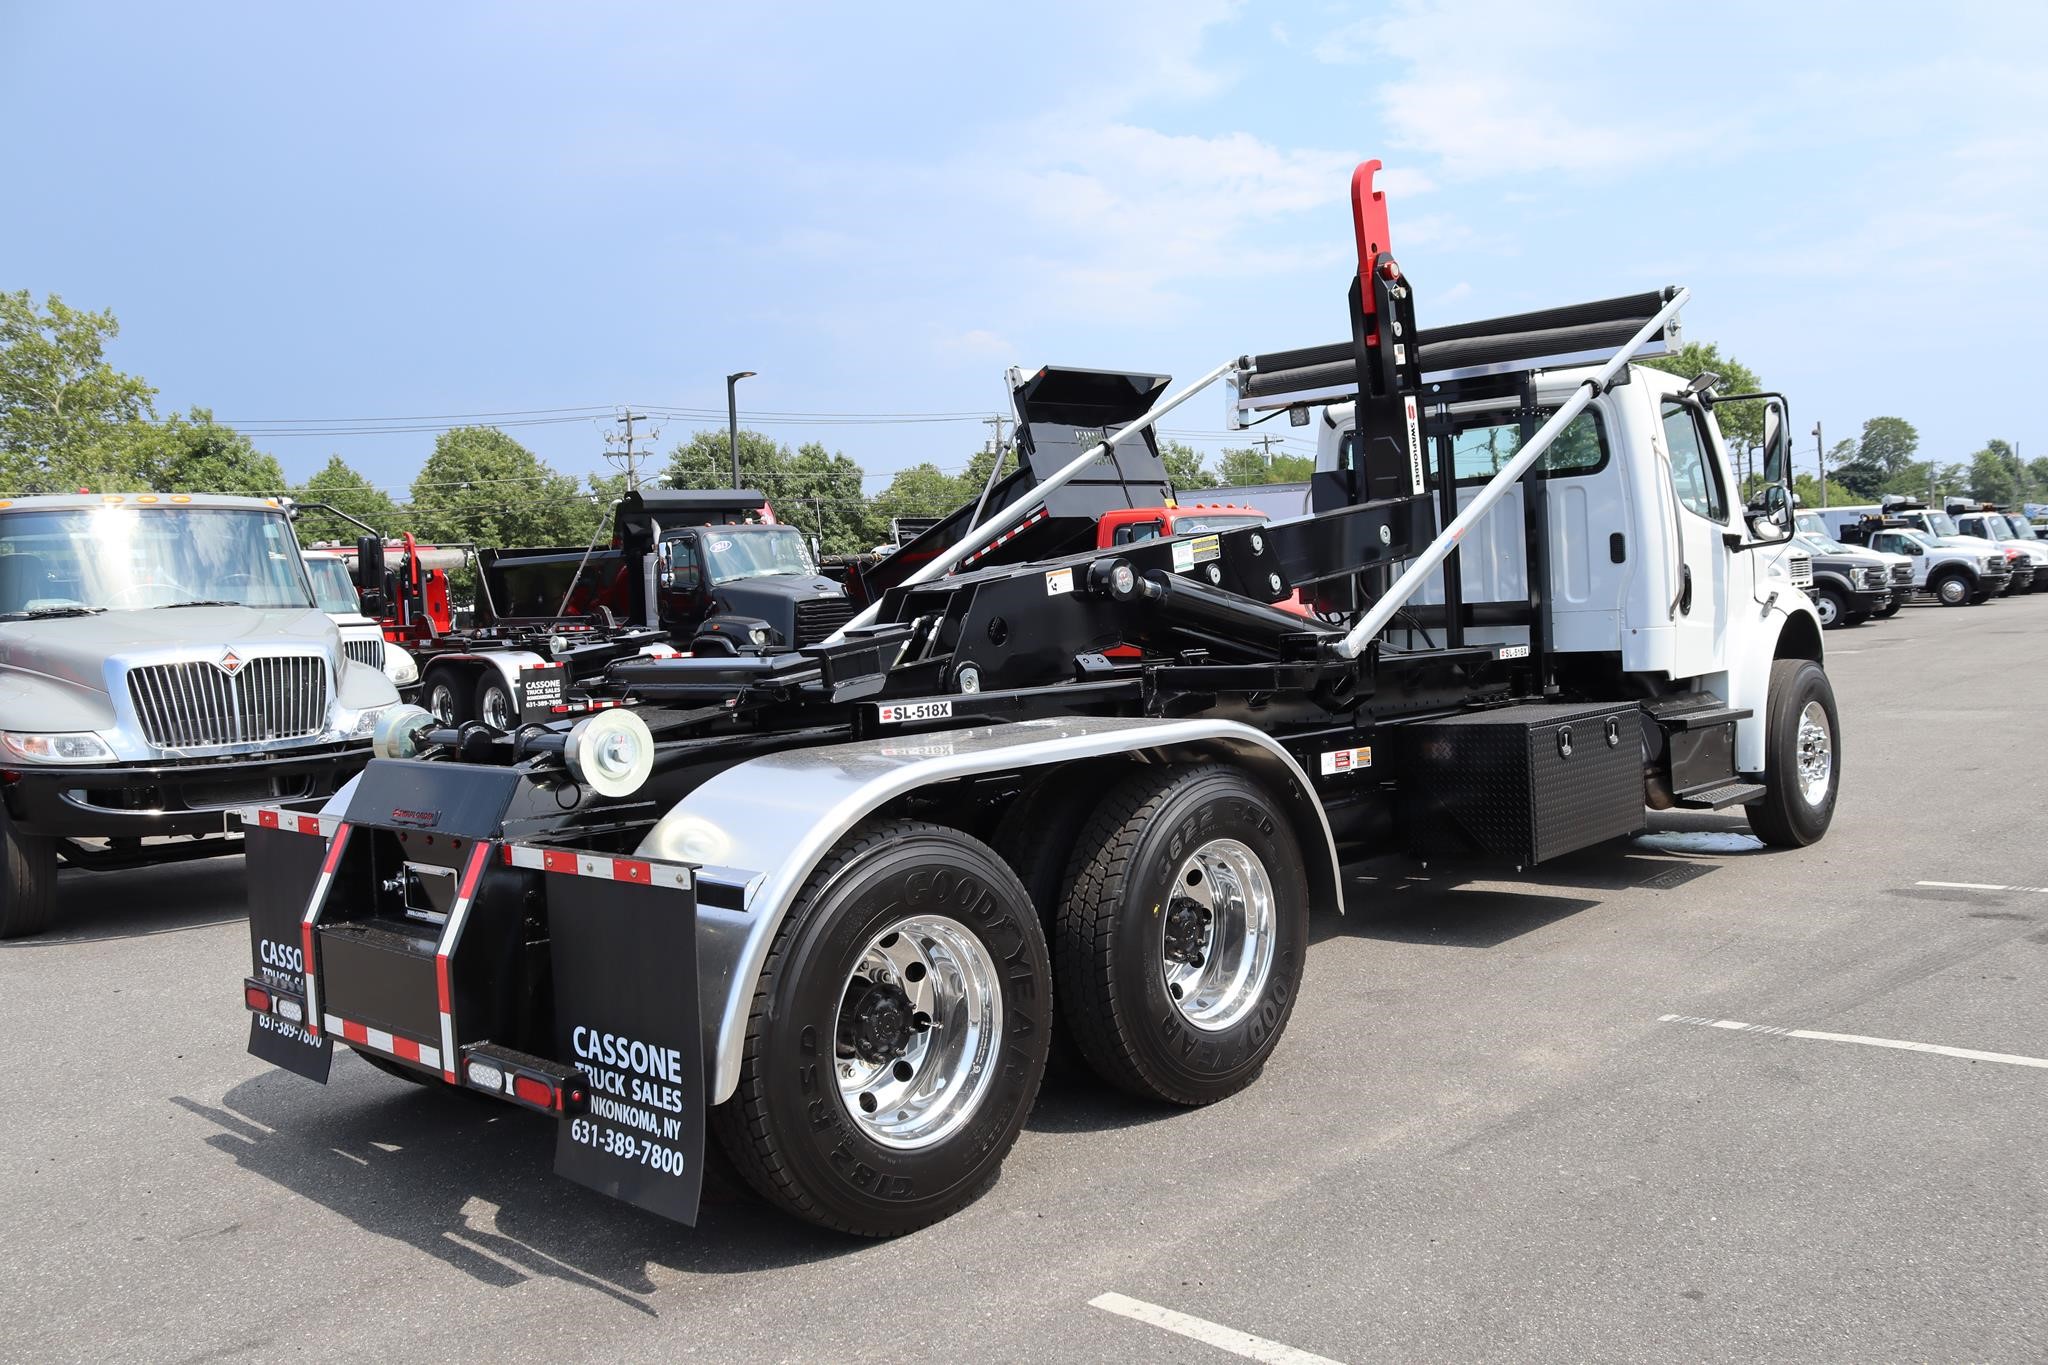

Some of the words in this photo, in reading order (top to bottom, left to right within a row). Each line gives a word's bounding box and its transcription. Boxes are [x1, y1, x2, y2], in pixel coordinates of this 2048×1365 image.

[1410, 422, 1421, 486] SWAPLOADER
[526, 679, 560, 690] CASSONE
[893, 702, 949, 721] SL-518X
[260, 939, 303, 973] CASSO
[902, 869, 1036, 1086] GOODYEAR
[573, 1025, 682, 1084] CASSONE
[798, 1023, 833, 1134] RSD
[590, 1094, 662, 1138] NKONKOMA,
[663, 1116, 682, 1141] NY
[631, 1078, 683, 1113] SALES
[571, 1118, 684, 1177] 631-389-7800
